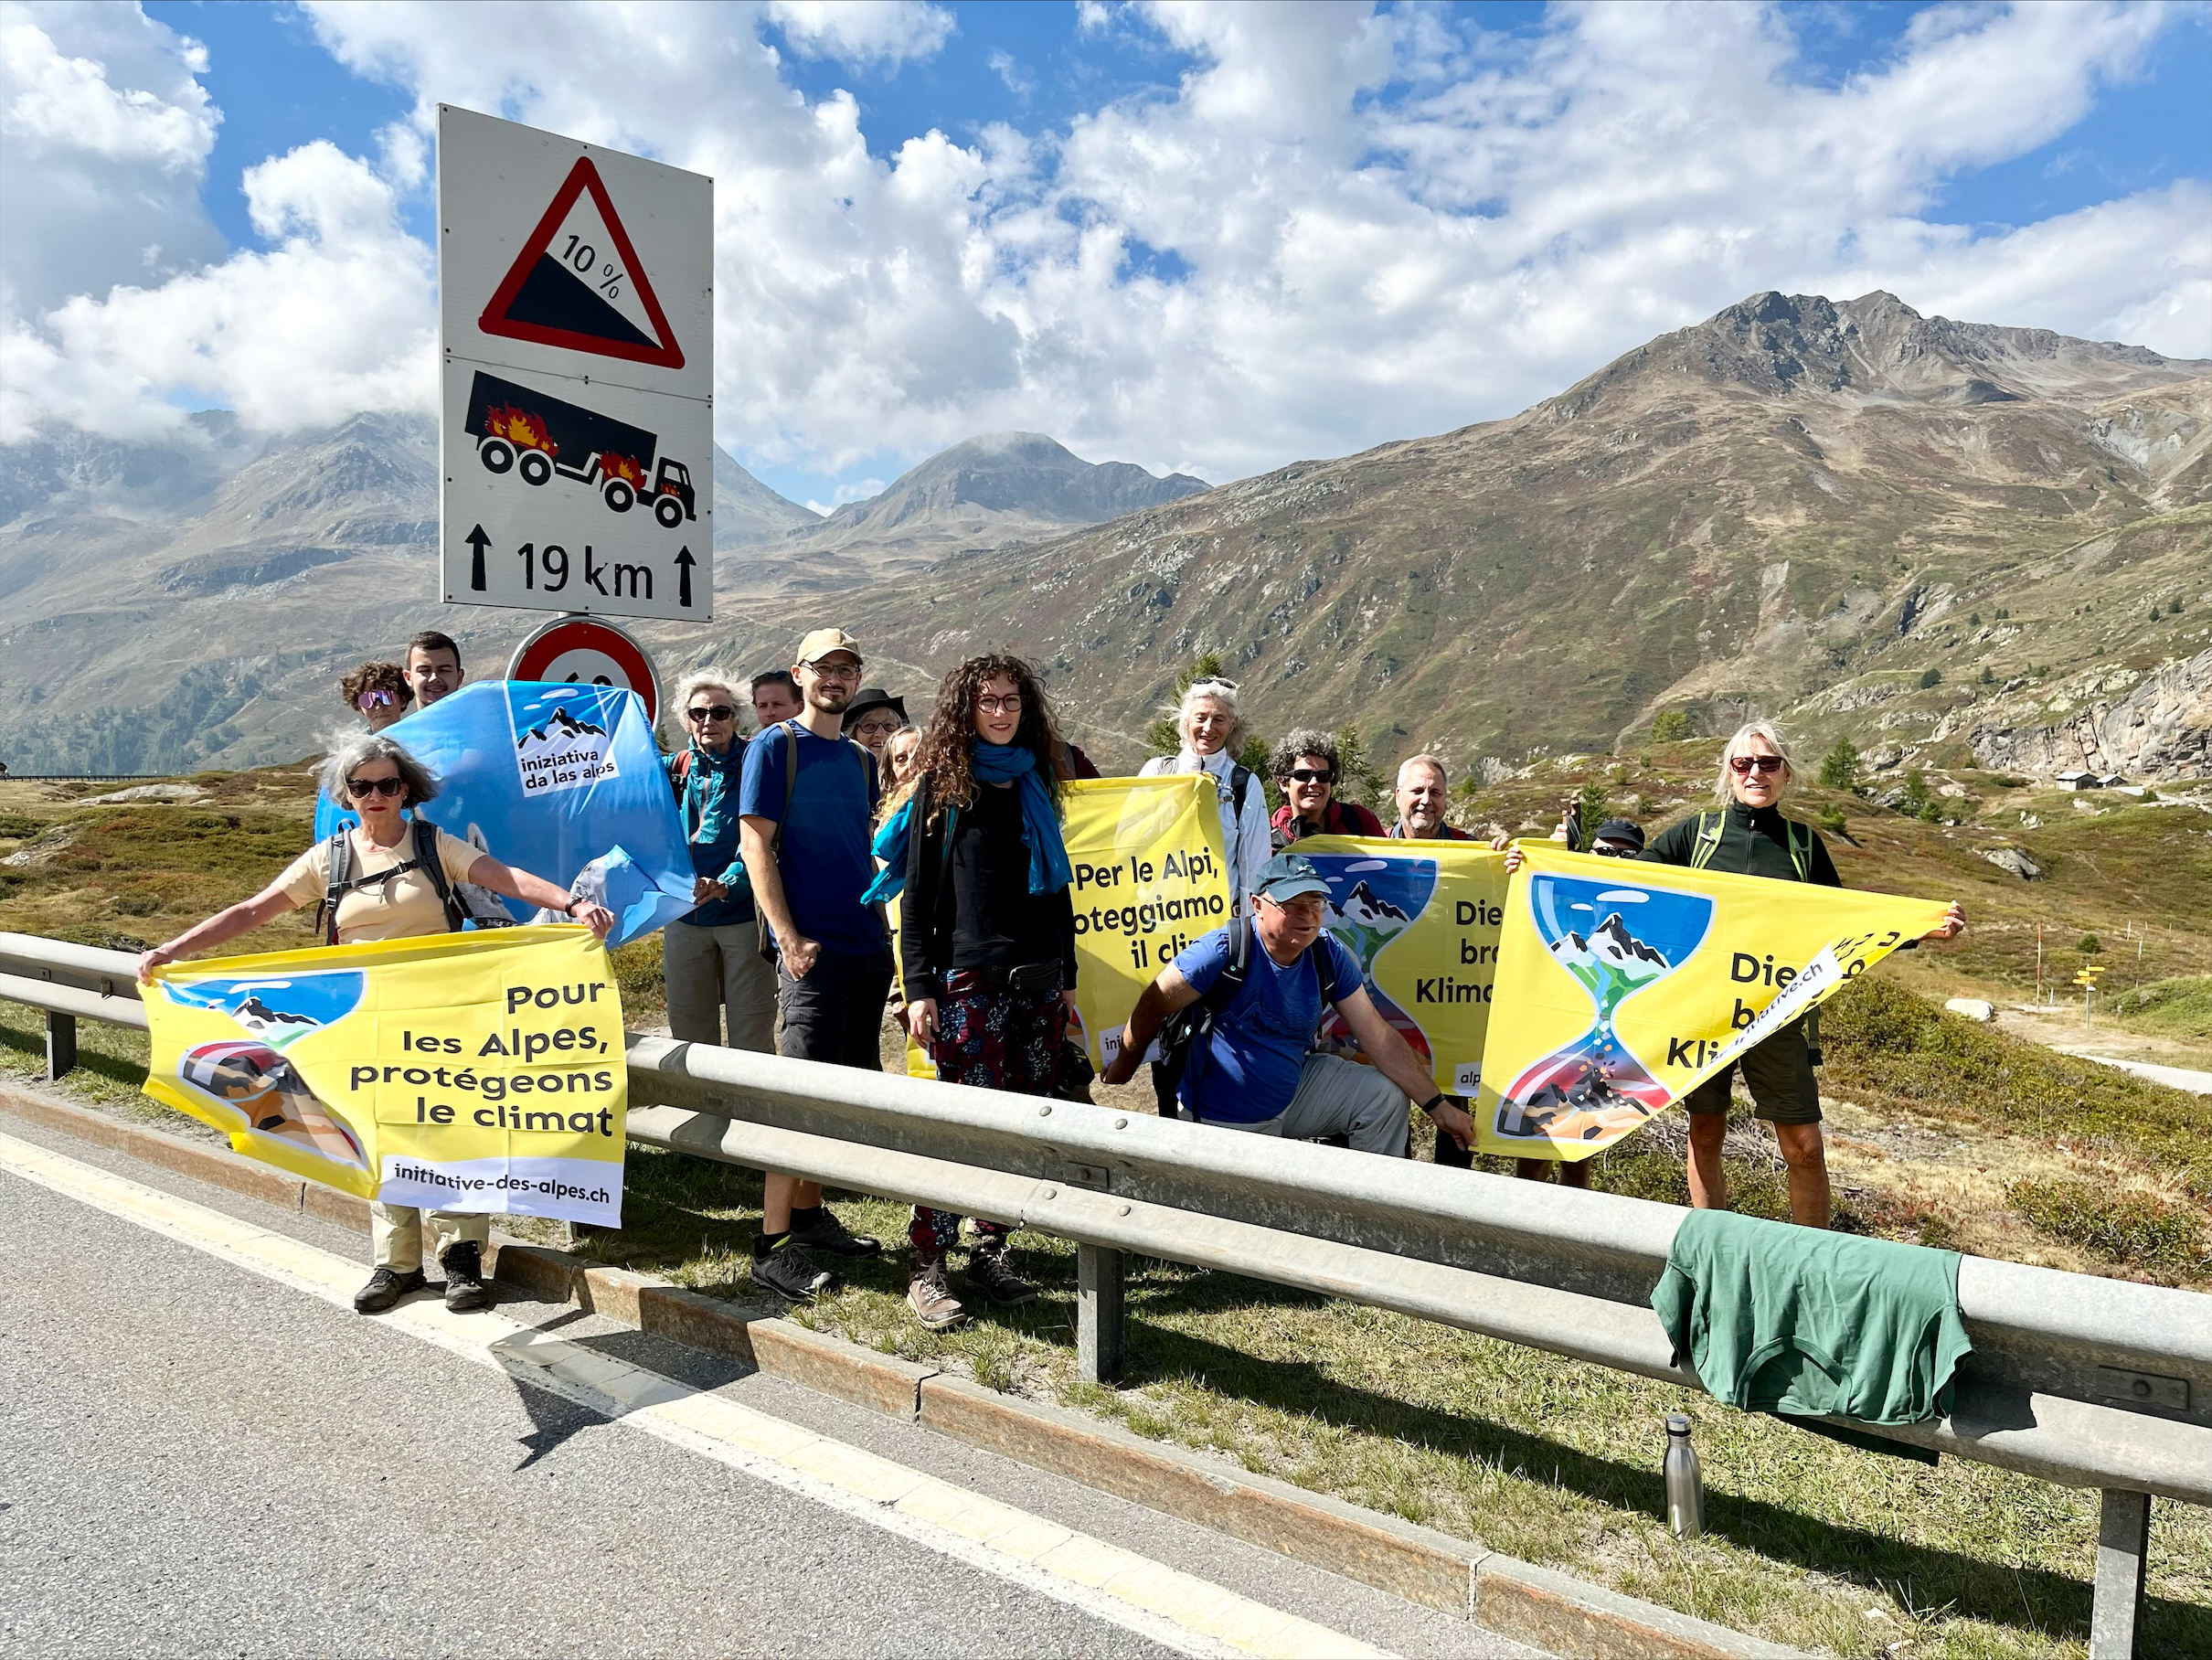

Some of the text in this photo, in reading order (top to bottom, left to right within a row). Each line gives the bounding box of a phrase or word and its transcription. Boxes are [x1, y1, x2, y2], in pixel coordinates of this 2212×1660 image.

[563, 235, 624, 300] 10 %
[517, 543, 653, 600] 19 km
[521, 750, 599, 772] iniziativa
[526, 762, 614, 790] da las alps
[1075, 846, 1218, 890] Per le Alpi,
[1456, 899, 1503, 925] Die
[1131, 932, 1194, 969] il cli
[1730, 952, 1797, 989] Die
[507, 983, 605, 1014] Pour
[404, 1027, 608, 1062] les Alpes,
[351, 1066, 612, 1101] protégeons
[417, 1097, 613, 1136] le climat
[395, 1164, 609, 1203] initiative-des-alpes.ch
